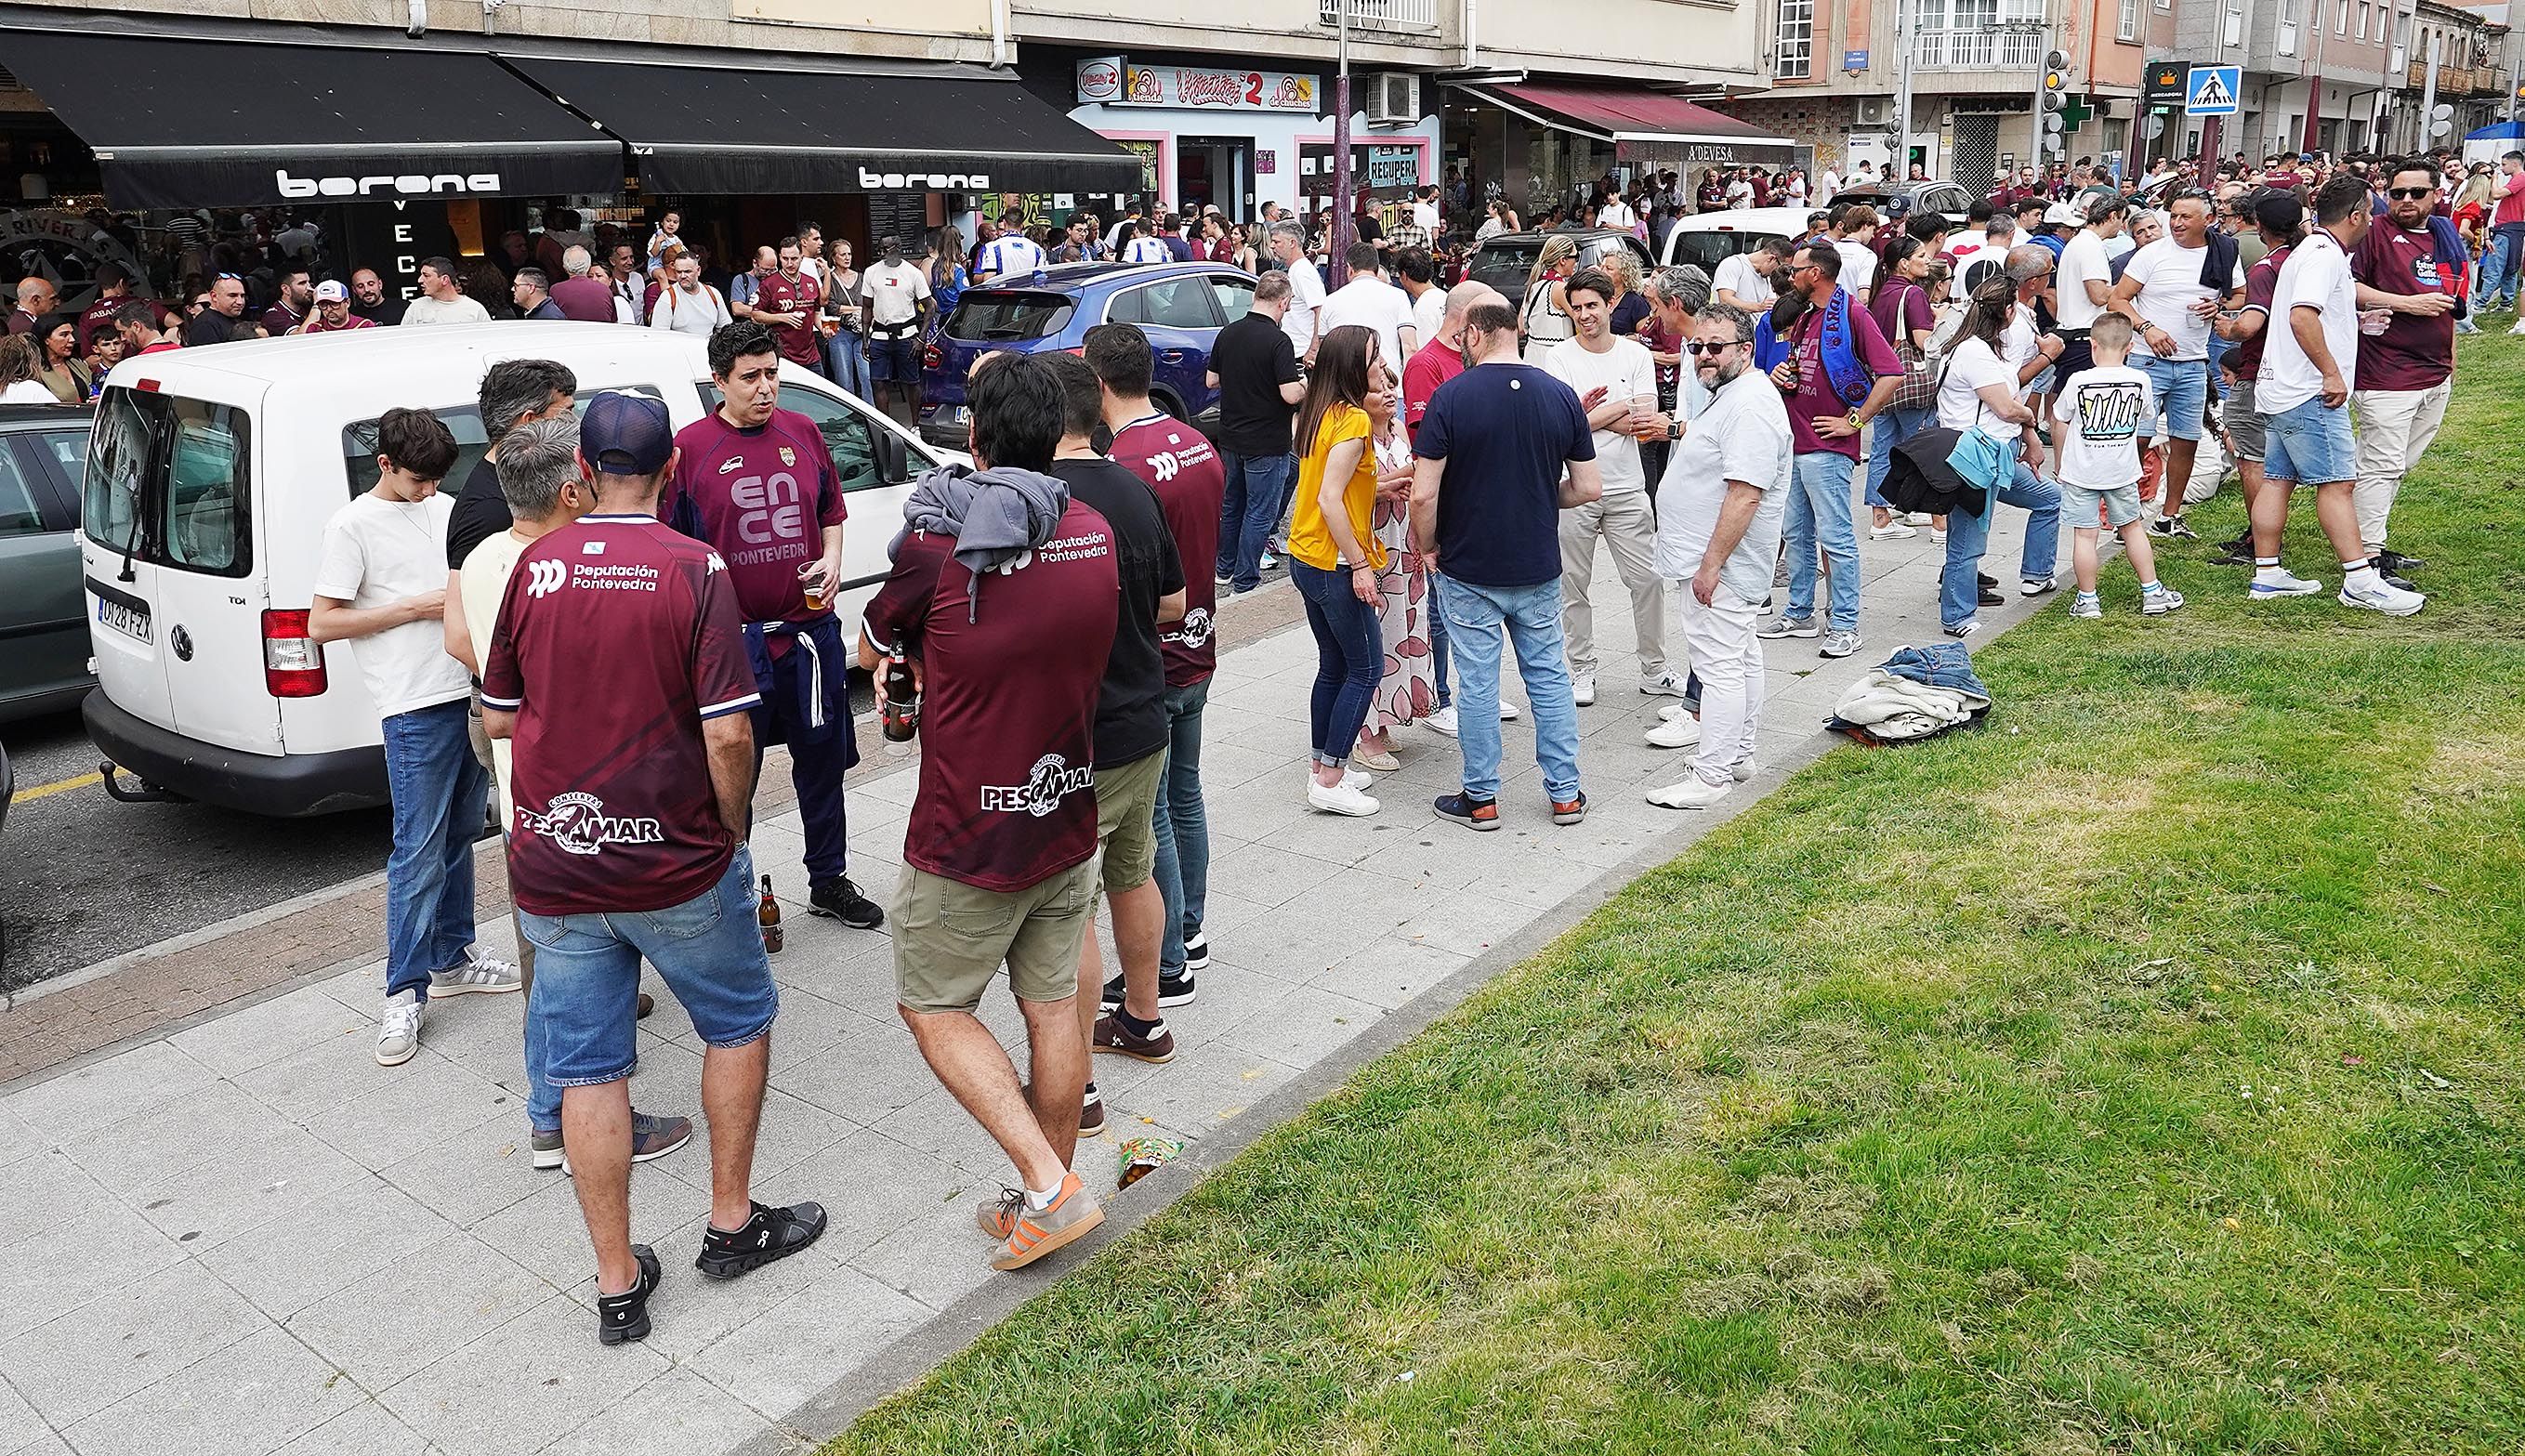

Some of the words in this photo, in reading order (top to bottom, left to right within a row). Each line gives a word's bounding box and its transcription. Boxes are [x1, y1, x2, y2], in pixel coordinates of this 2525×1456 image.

[1133, 92, 1164, 103] tienda
[1245, 72, 1264, 106] 2
[1269, 96, 1281, 107] de
[1280, 97, 1311, 109] chuches
[858, 166, 990, 190] borona
[1371, 160, 1417, 178] RECUPERA
[276, 169, 501, 198] borona
[730, 542, 809, 567] PONTEVEDR
[1039, 545, 1108, 563] Pontevedra
[573, 563, 659, 579] Deputación
[572, 577, 657, 592] Pontevedra
[129, 611, 151, 640] FZX
[547, 792, 604, 809] CONSERVAS
